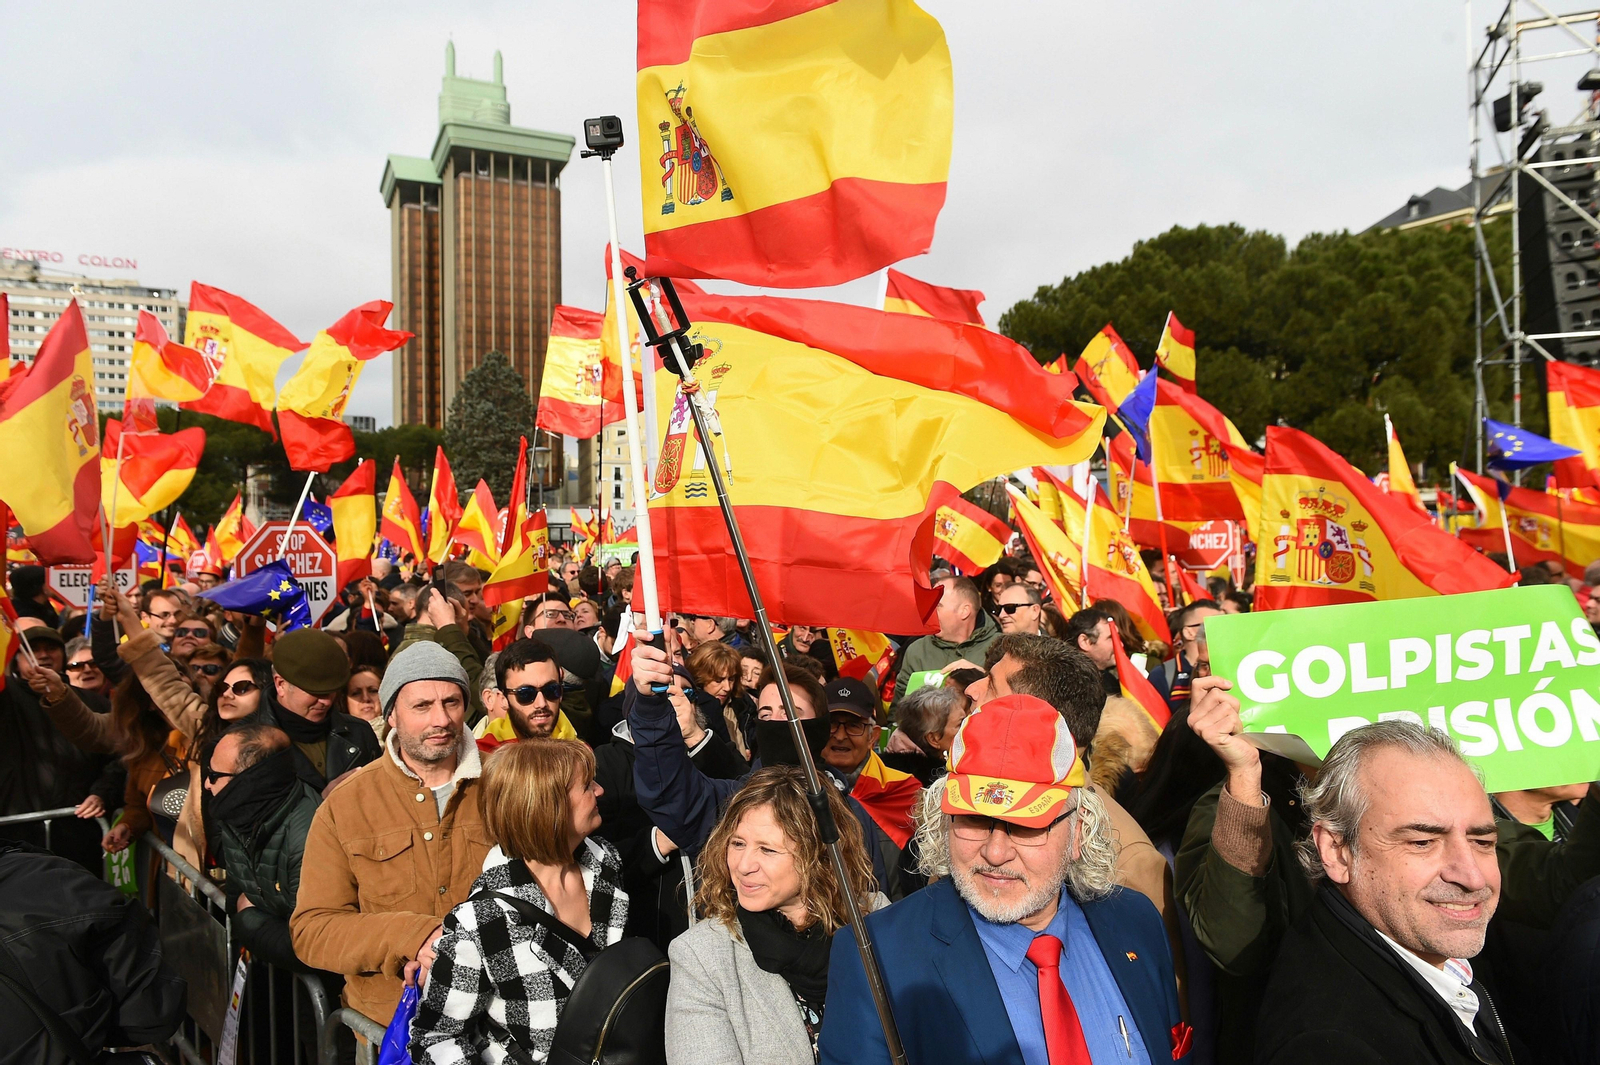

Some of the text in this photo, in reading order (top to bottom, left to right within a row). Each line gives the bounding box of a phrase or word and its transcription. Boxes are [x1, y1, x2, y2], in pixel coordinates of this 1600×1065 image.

[78, 254, 138, 270] COLON
[1189, 533, 1228, 550] NCHEZ
[254, 548, 323, 575] SÁCHEZ
[59, 573, 128, 587] ELECES
[1236, 617, 1600, 704] GOLPISTAS
[1327, 676, 1600, 757] SIÓN
[1028, 795, 1053, 814] ESPAÑA
